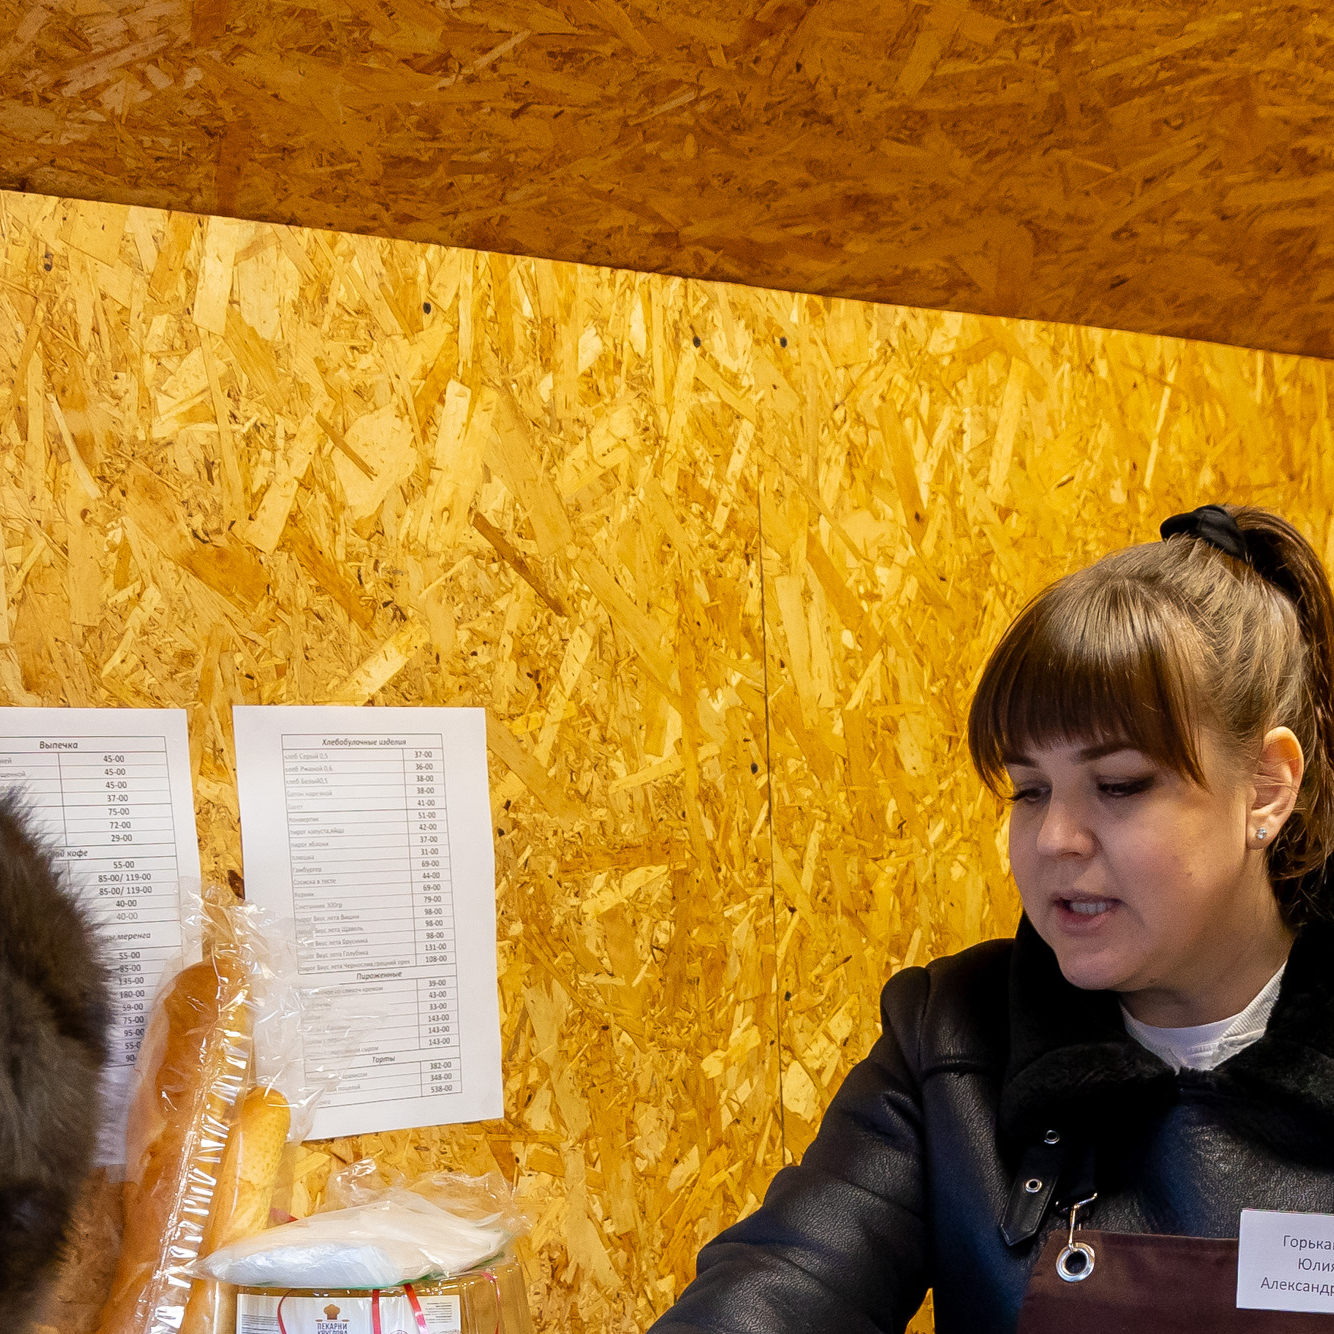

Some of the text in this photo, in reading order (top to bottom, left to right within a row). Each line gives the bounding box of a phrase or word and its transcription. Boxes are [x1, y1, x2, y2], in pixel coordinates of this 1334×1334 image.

[40, 741, 78, 749] Выпечка
[322, 739, 377, 747] Хлебобулочные
[106, 781, 127, 789] 45-00
[67, 849, 88, 858] кофе
[113, 861, 134, 869] 55-00
[98, 873, 151, 882] 85-00/ 119-00
[99, 886, 152, 895] 85-00/ 119-00
[117, 912, 138, 920] 40-00
[425, 943, 446, 951] 131-00
[119, 952, 140, 960] 55-00
[426, 955, 447, 963] 108-00
[119, 964, 141, 972] 85-00
[119, 977, 144, 985] 135-00
[120, 990, 144, 999] 180-00
[123, 1016, 144, 1024] 75-00
[428, 1014, 449, 1022] 143-00
[429, 1026, 449, 1034] 143-00
[430, 1061, 451, 1069] 382-00
[431, 1073, 452, 1081] 348-00
[431, 1085, 452, 1093] 538-00
